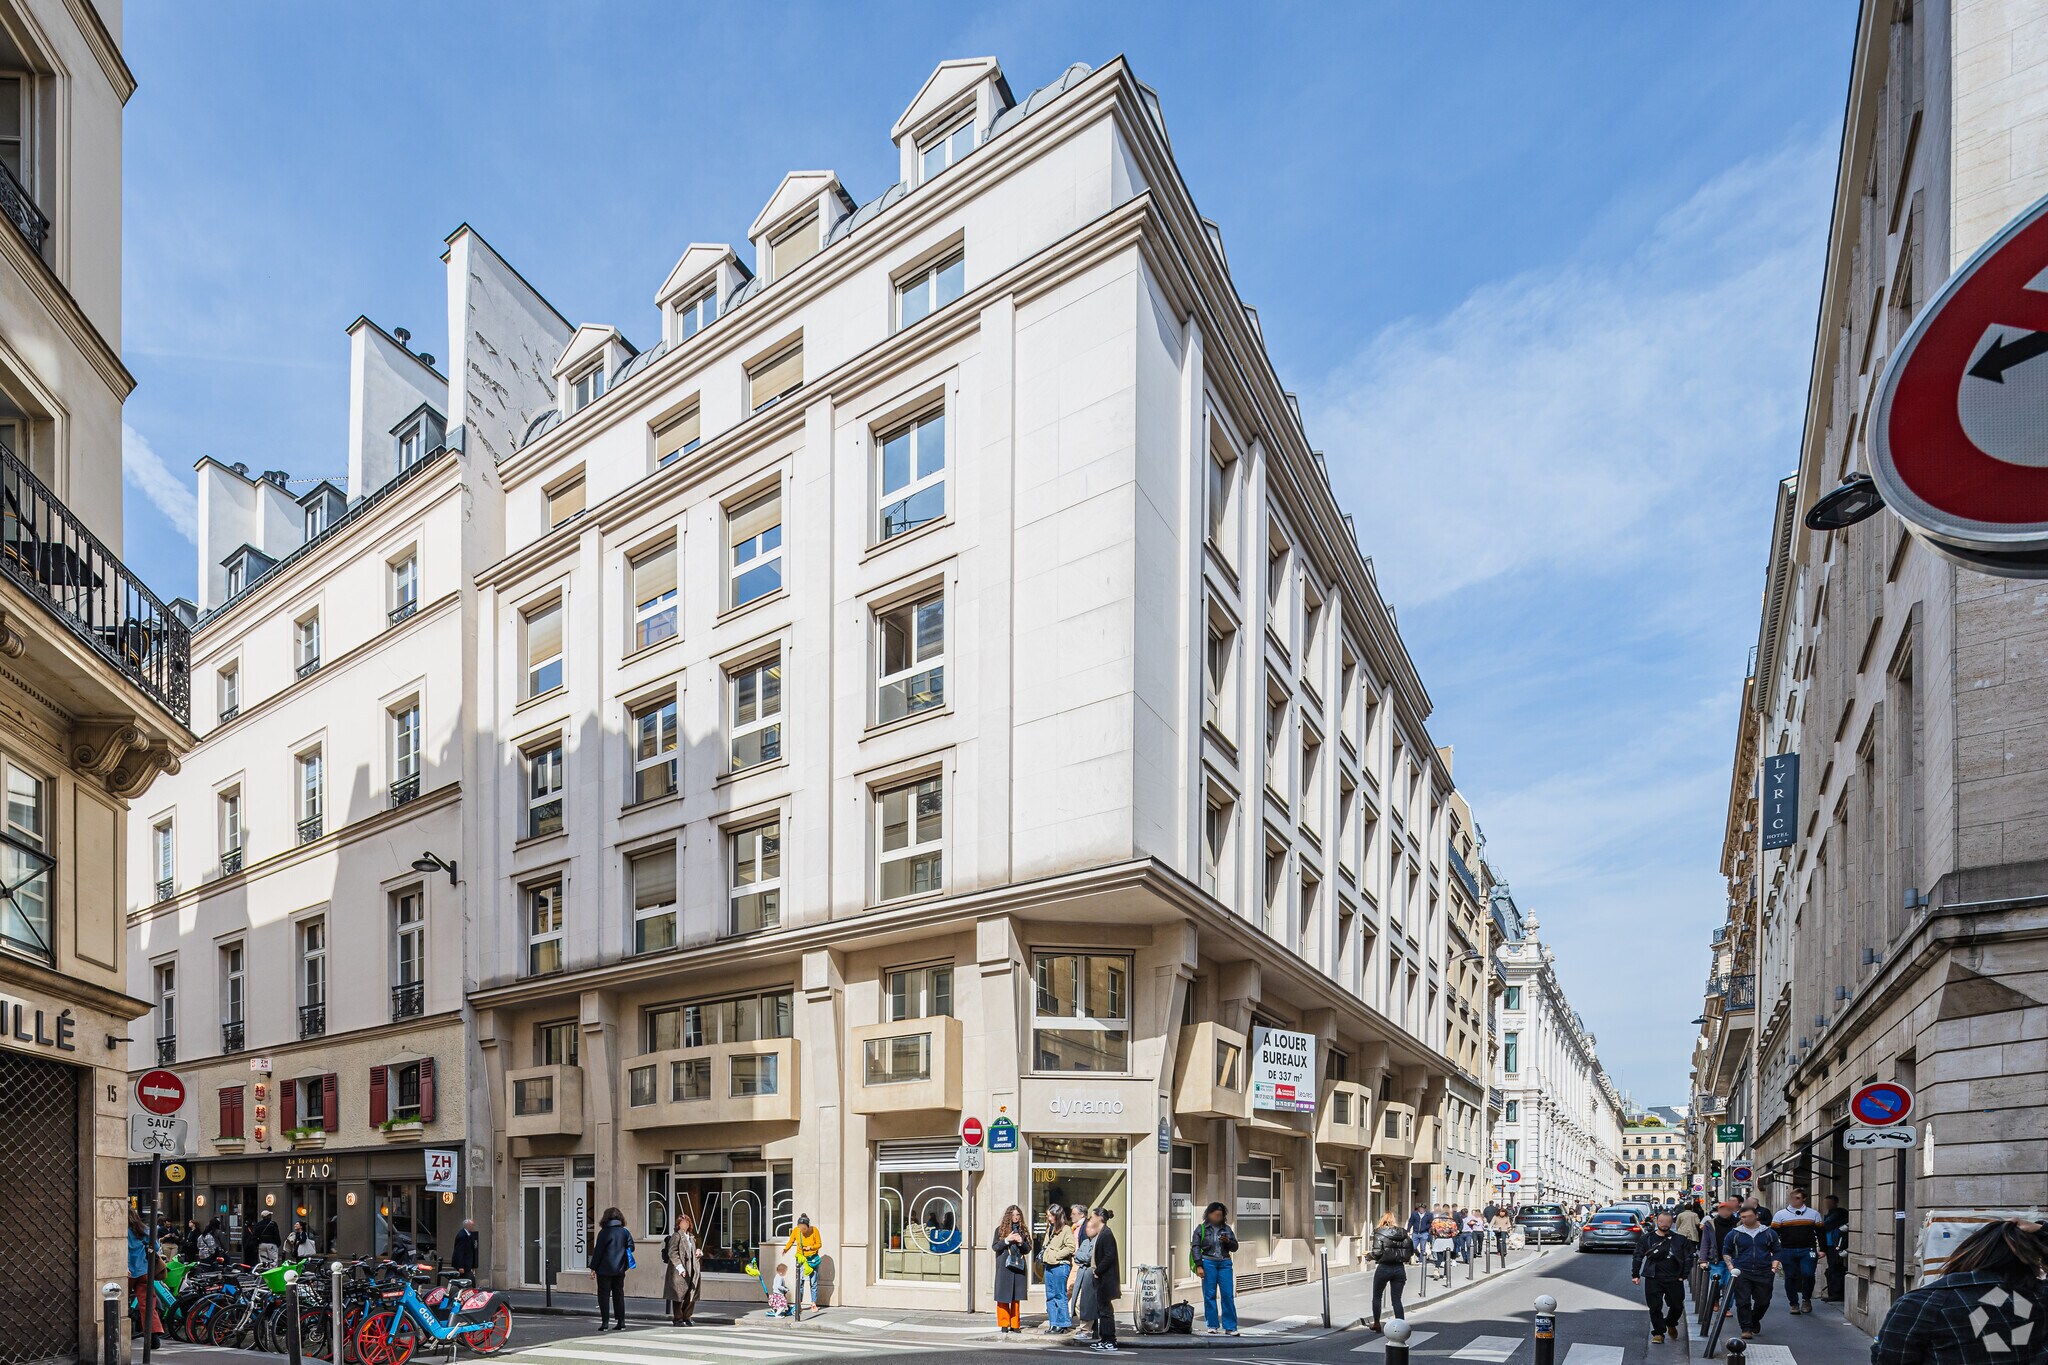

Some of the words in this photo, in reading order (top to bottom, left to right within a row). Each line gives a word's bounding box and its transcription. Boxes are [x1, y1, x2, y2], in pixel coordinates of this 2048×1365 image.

[1773, 759, 1785, 829] LYRIC
[1766, 832, 1790, 840] HOTEL
[1274, 1033, 1307, 1051] LOUER
[1263, 1050, 1308, 1068] BUREAUX
[1268, 1069, 1277, 1080] DE
[1278, 1071, 1292, 1081] 337
[107, 1084, 117, 1103] 15
[1049, 1096, 1124, 1118] dynamo
[147, 1117, 176, 1130] SAUF
[431, 1154, 452, 1168] ZH
[285, 1163, 330, 1179] ZHAO
[1245, 1200, 1262, 1213] dynamo
[574, 1197, 586, 1254] dynamo
[419, 1307, 436, 1327] dott
